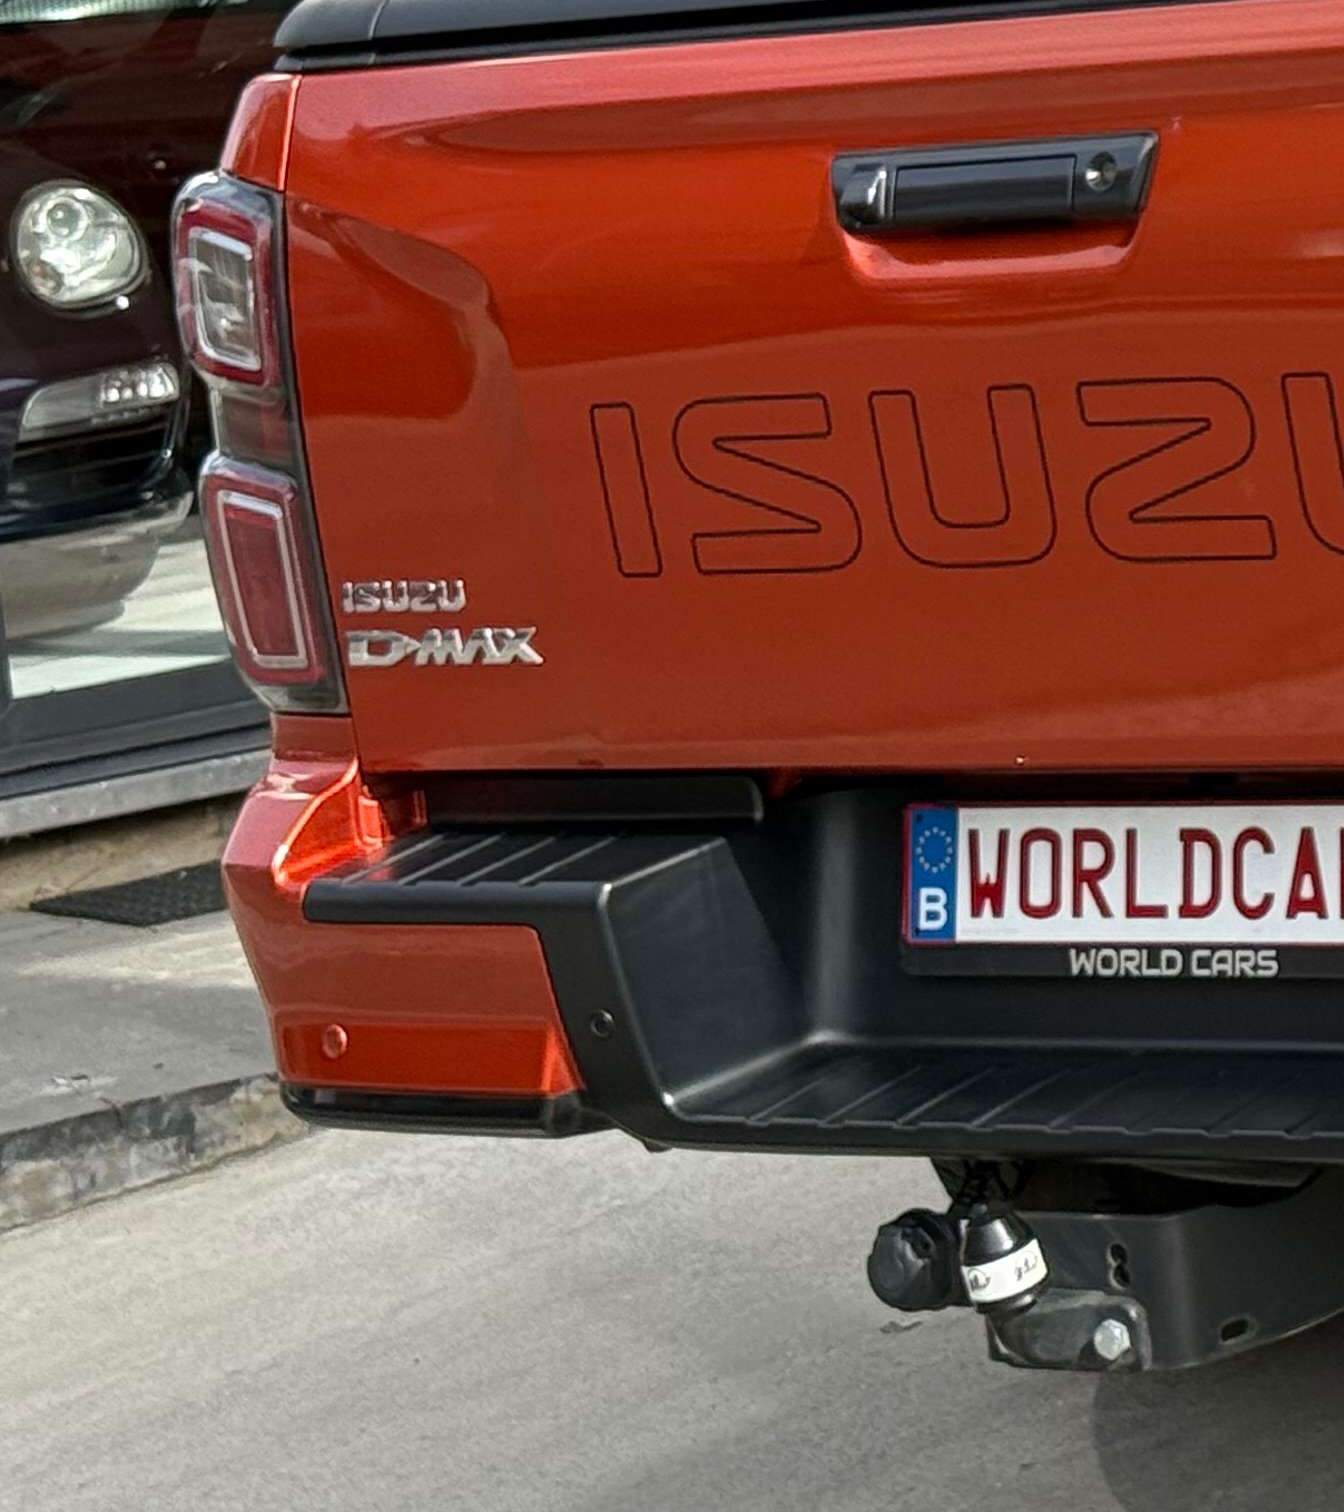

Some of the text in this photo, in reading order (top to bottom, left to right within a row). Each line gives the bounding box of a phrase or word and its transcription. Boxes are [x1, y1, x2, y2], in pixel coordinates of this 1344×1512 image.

[342, 579, 467, 613] ISUZU
[918, 888, 949, 931] B
[1069, 948, 1280, 977] WORLD CARS
